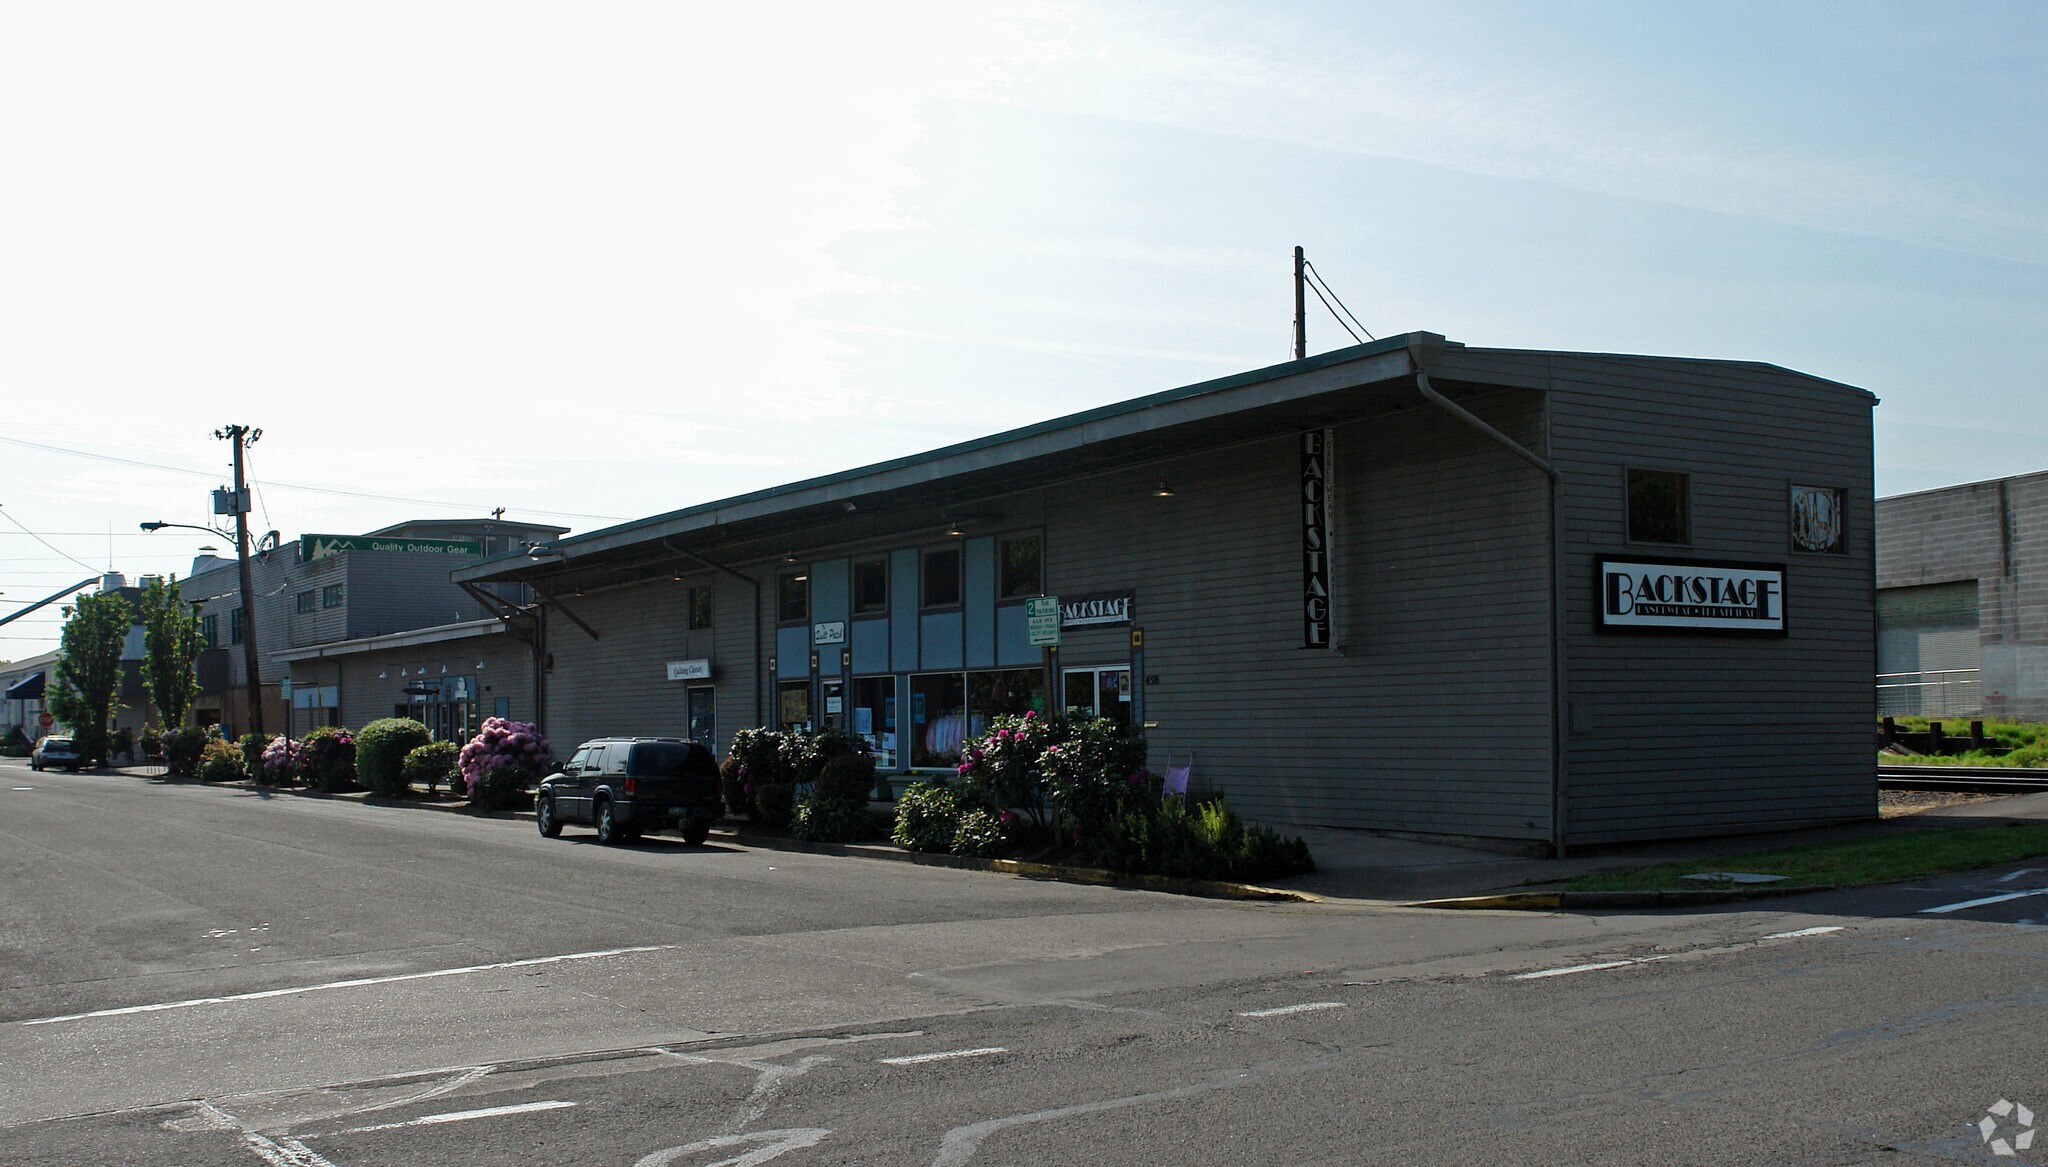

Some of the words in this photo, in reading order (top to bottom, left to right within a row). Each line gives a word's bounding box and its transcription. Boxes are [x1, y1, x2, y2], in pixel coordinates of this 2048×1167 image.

[1303, 432, 1327, 644] BACKSTAGE
[371, 541, 404, 554] Quality
[407, 543, 443, 554] Outdoor
[446, 544, 469, 555] Gear
[1606, 572, 1780, 621] BACKSTAGE
[1027, 602, 1035, 615] 2
[1145, 676, 1159, 685] 450
